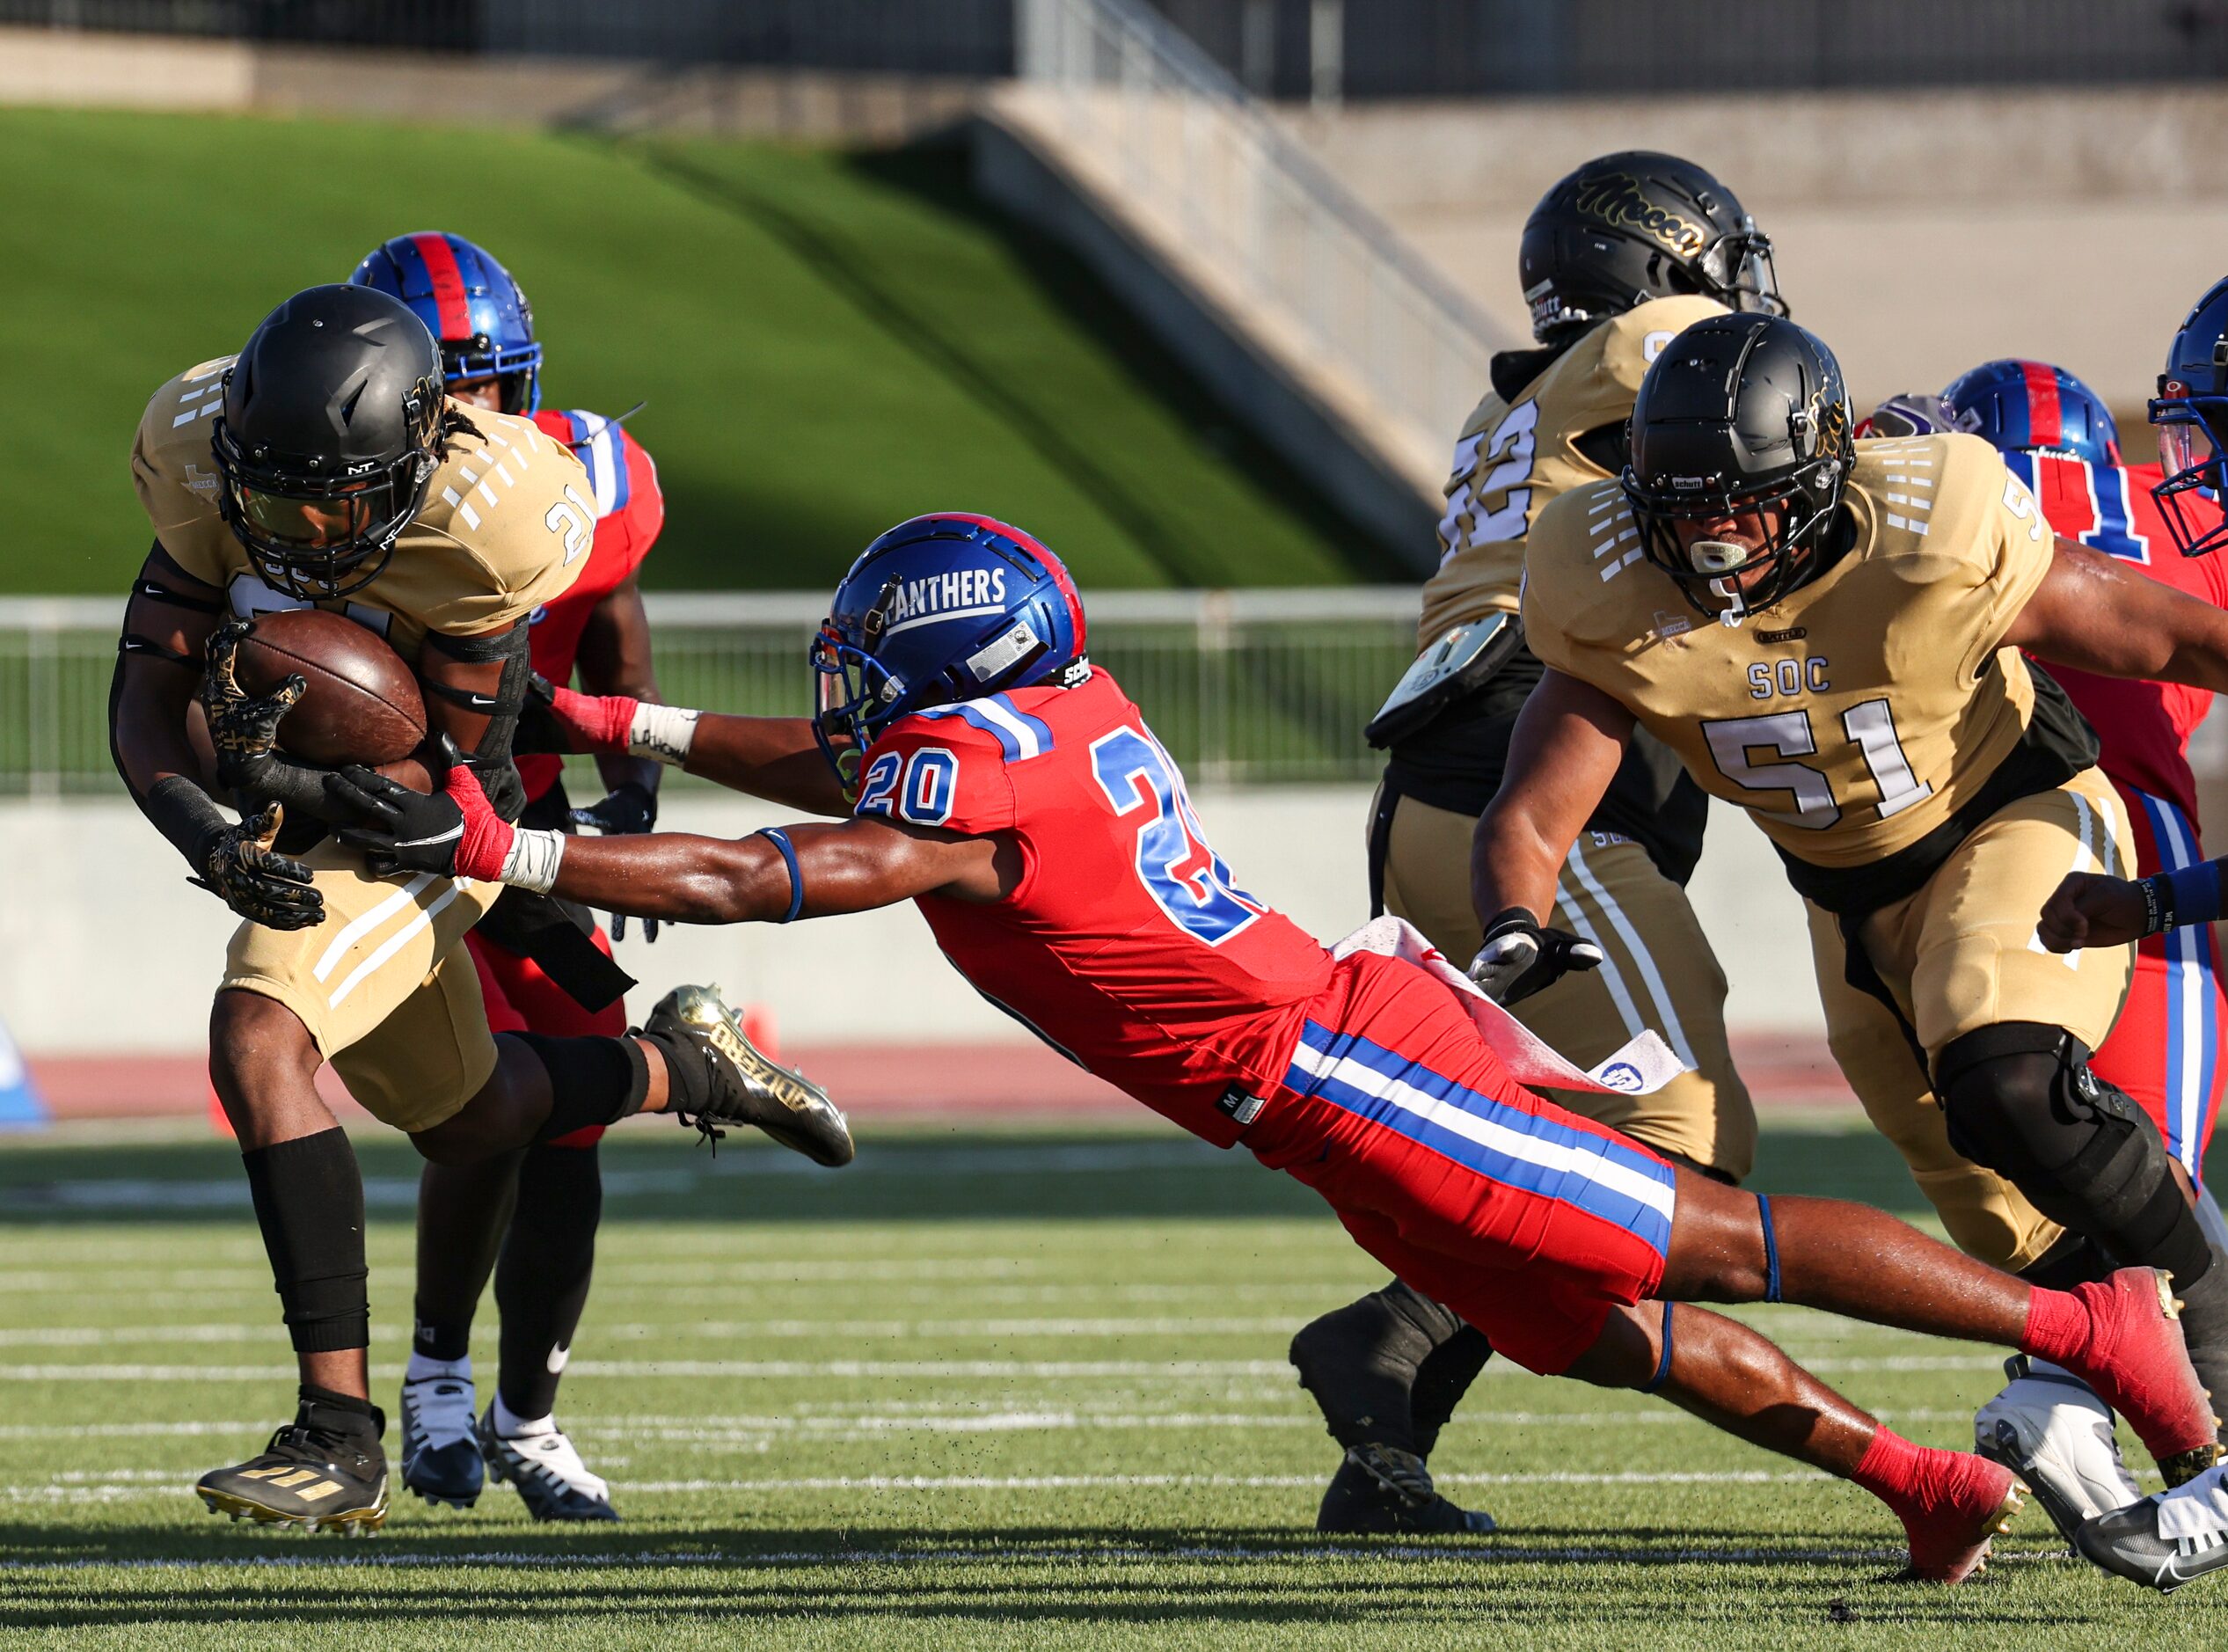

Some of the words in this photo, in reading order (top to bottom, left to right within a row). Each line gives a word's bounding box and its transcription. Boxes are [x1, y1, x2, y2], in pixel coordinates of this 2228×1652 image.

[1577, 173, 1705, 253] Mecca
[544, 483, 597, 567] 21
[2001, 466, 2042, 542] 5
[1747, 656, 1830, 699] SOC
[853, 747, 960, 827] 20
[1699, 698, 1934, 830] 51
